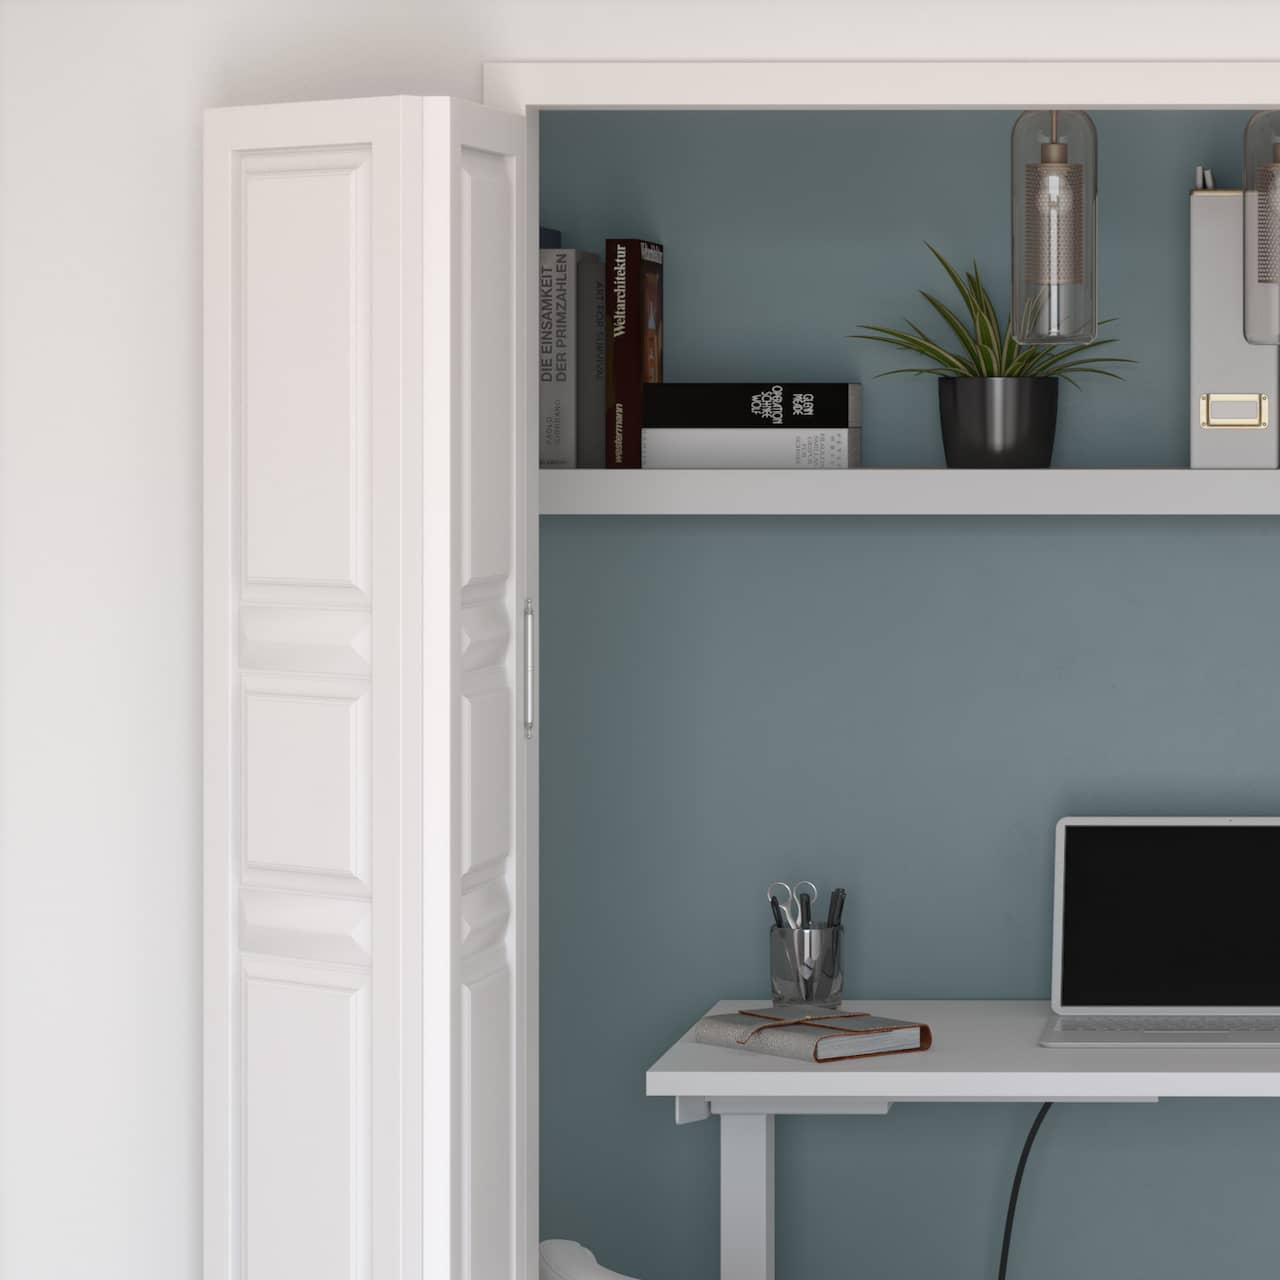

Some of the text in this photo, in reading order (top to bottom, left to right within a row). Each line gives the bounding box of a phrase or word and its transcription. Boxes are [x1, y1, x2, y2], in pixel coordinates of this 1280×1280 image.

[541, 265, 553, 382] DIE EINSAMKEIT
[555, 253, 568, 382] DER PRIMZAHLEN
[613, 243, 627, 338] Weltarchitektur
[615, 402, 624, 464] westermann
[751, 394, 762, 415] WOLF
[771, 385, 783, 424] OPERATION
